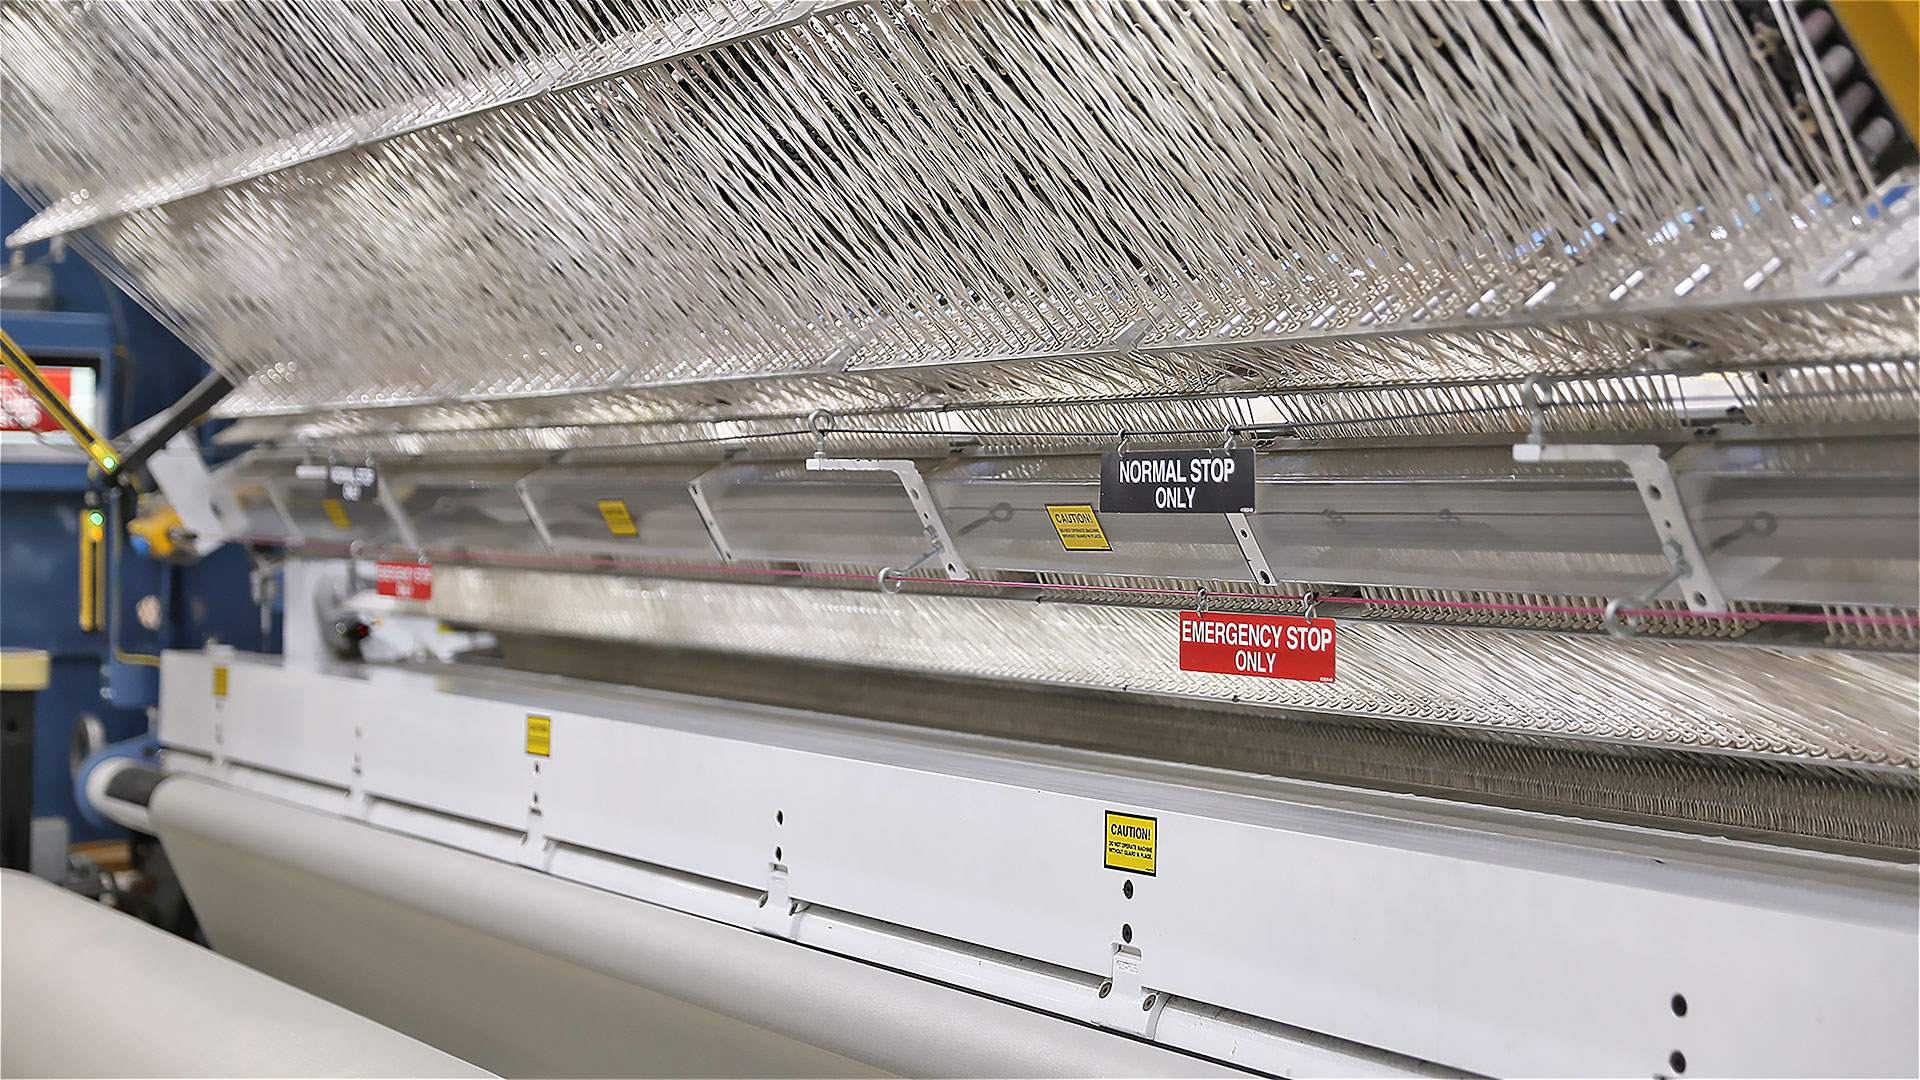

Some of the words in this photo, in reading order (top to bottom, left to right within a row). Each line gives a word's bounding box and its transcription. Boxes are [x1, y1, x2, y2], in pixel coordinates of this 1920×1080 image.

[1119, 459, 1187, 483] NORMAL
[1190, 458, 1235, 482] STOP
[1155, 486, 1196, 509] ONLY
[1054, 513, 1094, 524] CAUTION!
[1182, 620, 1283, 648] EMERGENCY
[1286, 625, 1333, 651] STOP
[1235, 650, 1276, 673] ONLY
[1110, 823, 1151, 841] CAUTION!
